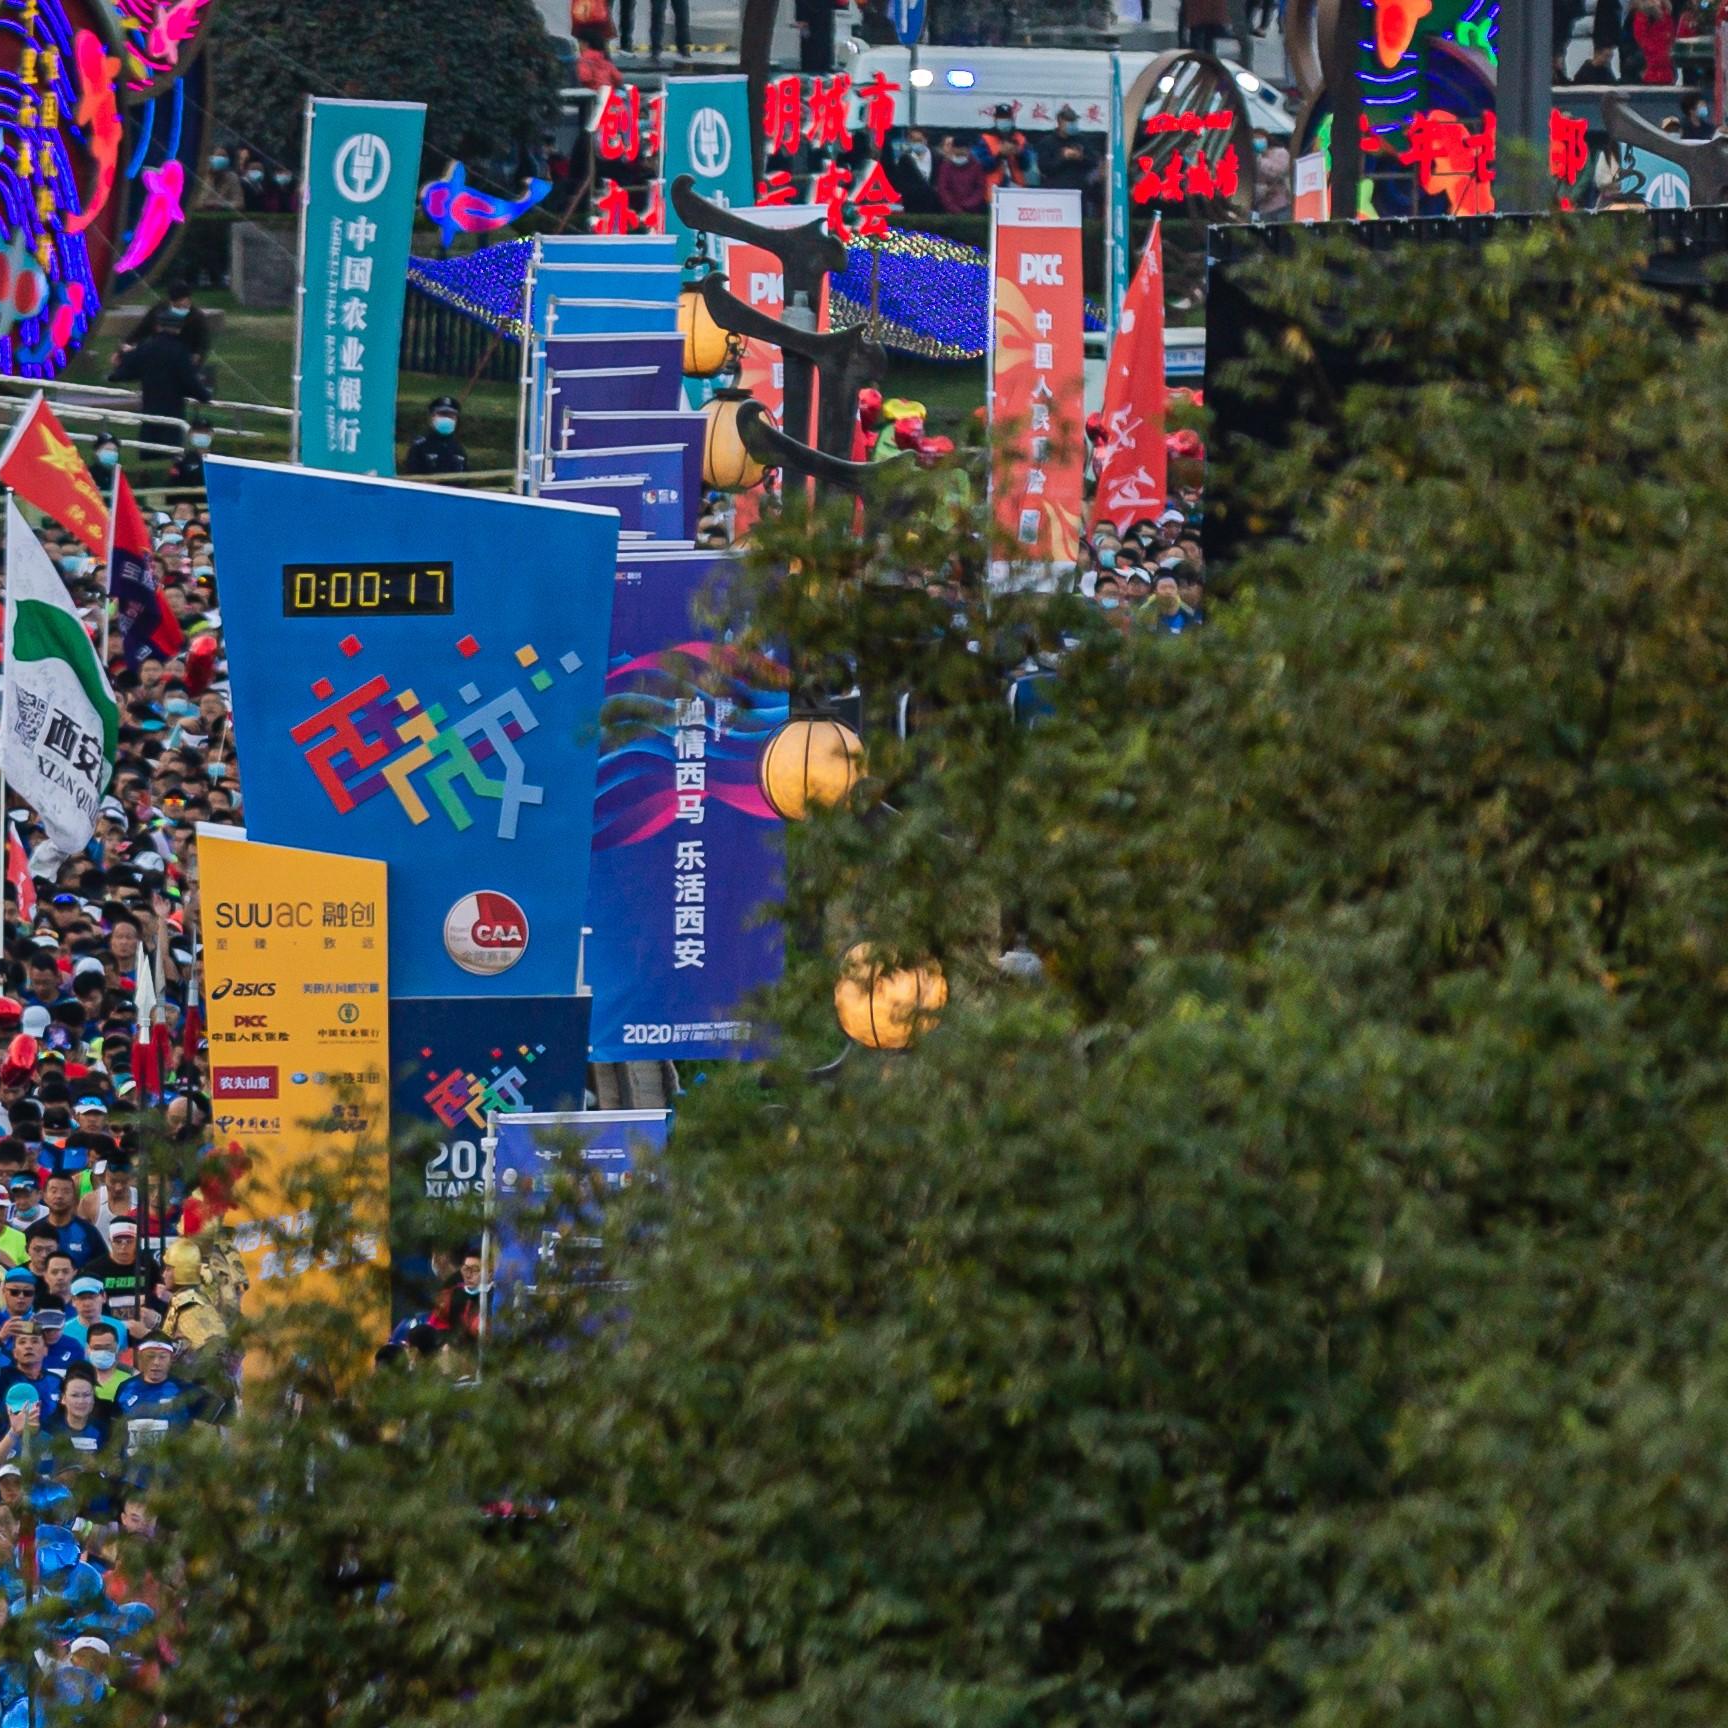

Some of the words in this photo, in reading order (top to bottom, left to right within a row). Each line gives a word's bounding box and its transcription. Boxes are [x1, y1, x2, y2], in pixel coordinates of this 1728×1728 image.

[599, 72, 901, 161] 创明城市
[1019, 253, 1063, 285] PICC
[339, 215, 377, 453] 中国农业银行
[294, 571, 445, 608] 0:00:17
[322, 902, 375, 928] 融创
[674, 840, 706, 969] 乐活西安
[476, 925, 522, 941] CAA
[234, 983, 276, 996] asics
[234, 1015, 268, 1028] PICC
[212, 1032, 290, 1043] 中国人民保险
[623, 1024, 671, 1044] 2020
[220, 1076, 271, 1090] 农夫山泉
